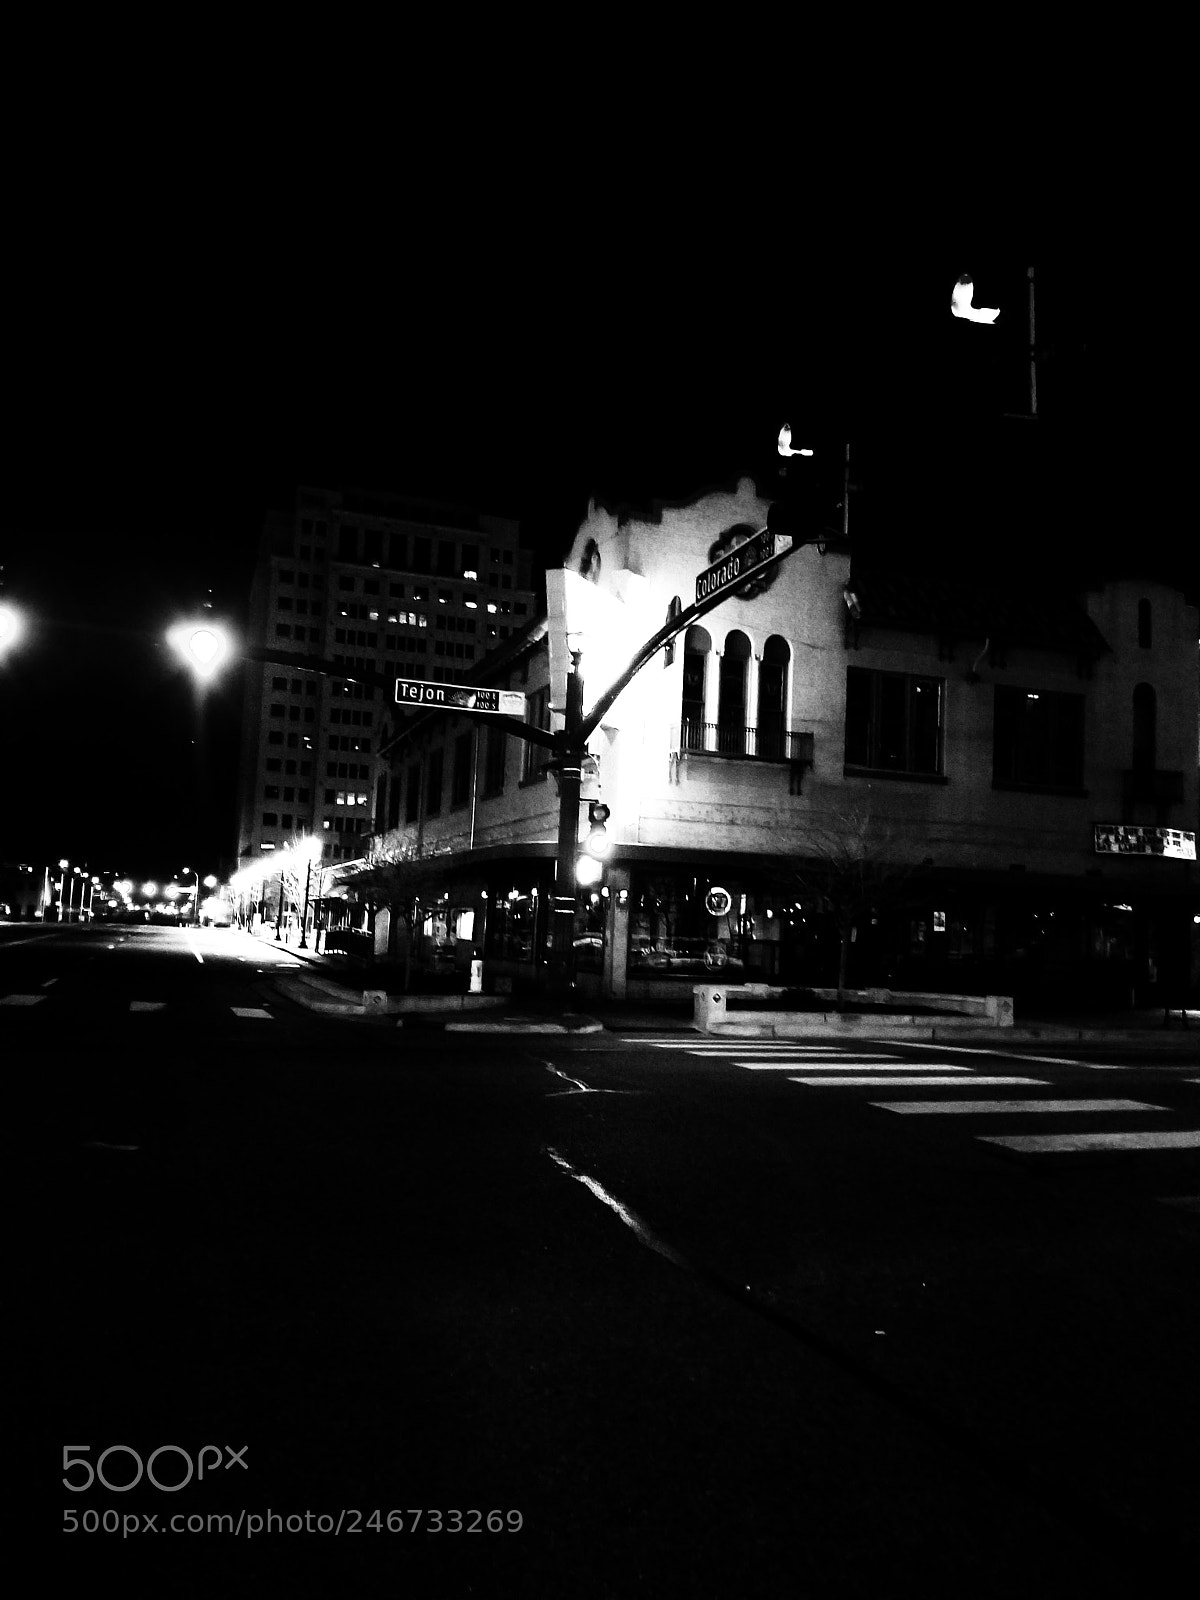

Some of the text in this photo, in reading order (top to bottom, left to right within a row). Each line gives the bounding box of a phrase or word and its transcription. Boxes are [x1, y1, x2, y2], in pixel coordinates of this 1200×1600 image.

[697, 557, 740, 599] Colorado
[401, 683, 445, 702] Tejon
[477, 690, 490, 700] 100
[476, 701, 490, 710] 100
